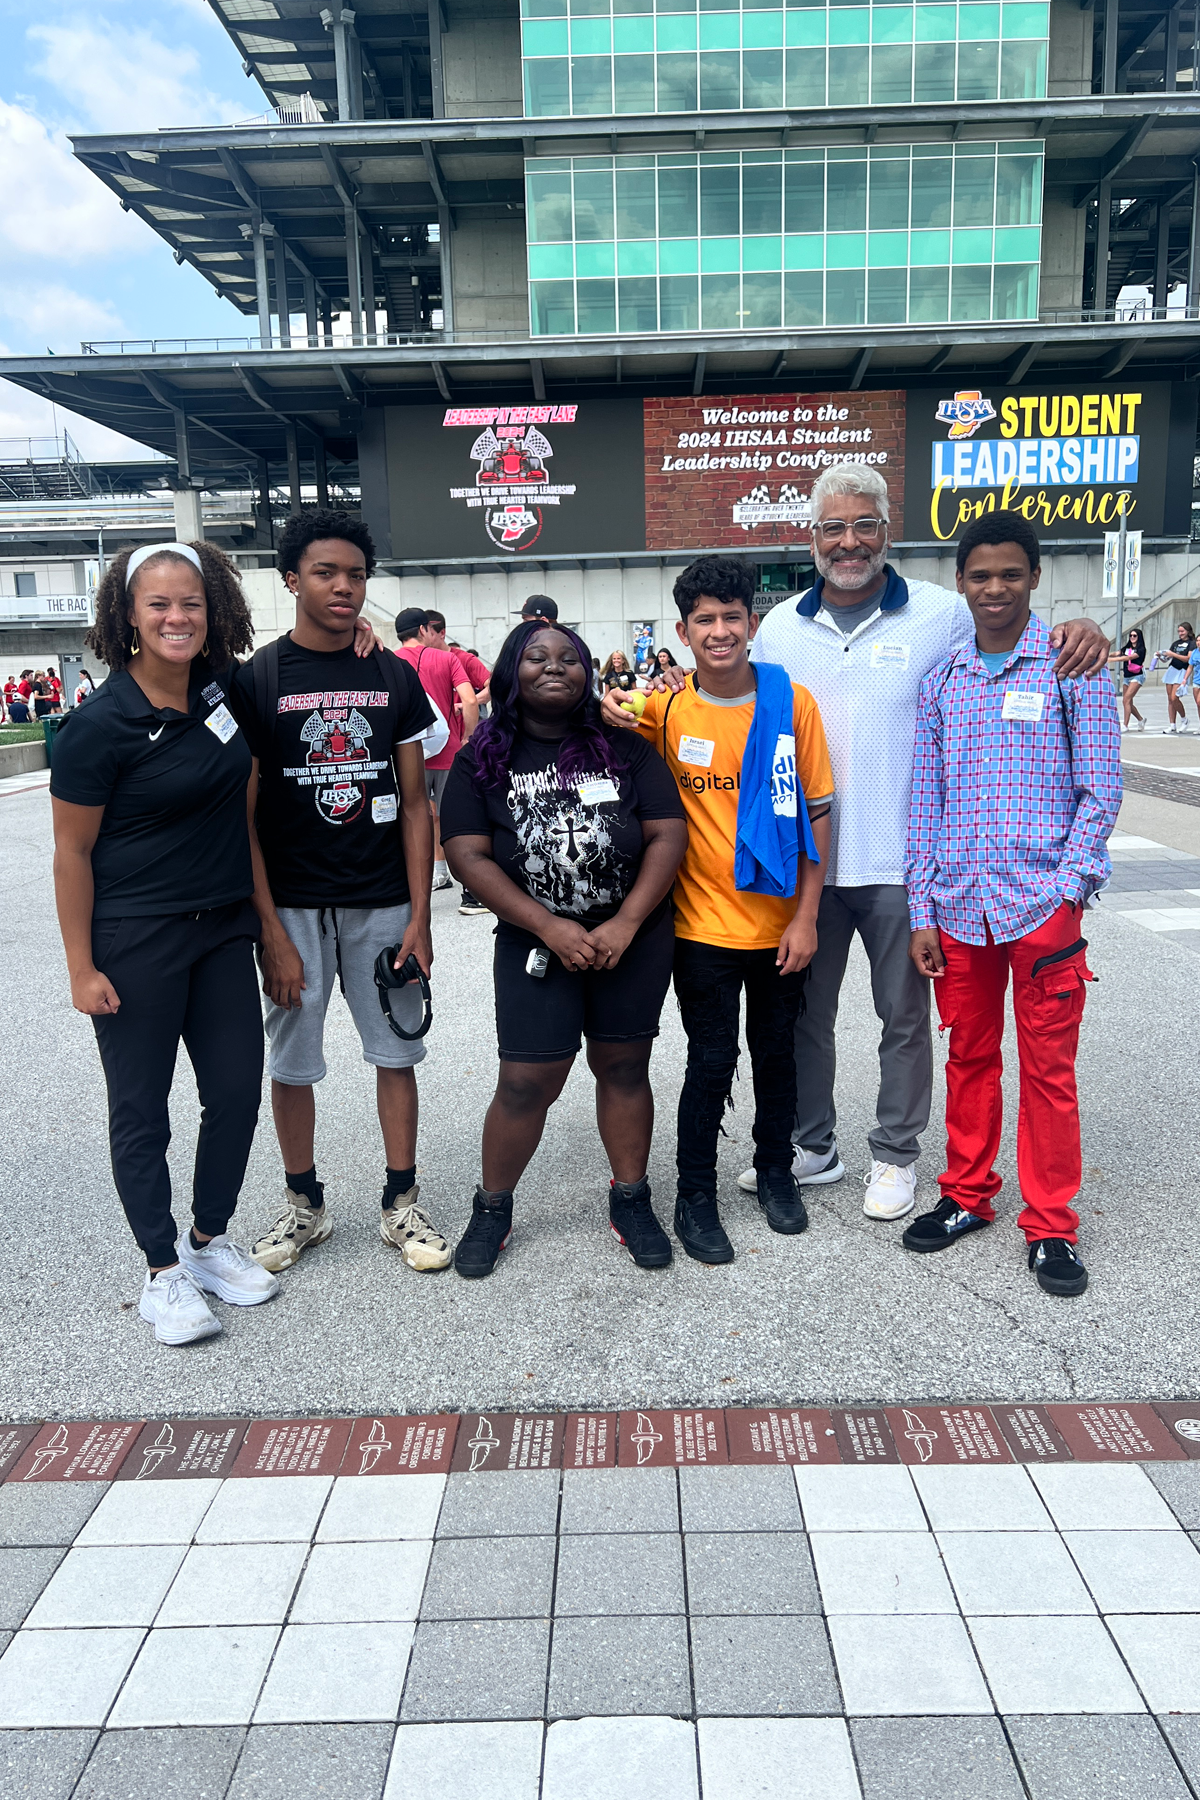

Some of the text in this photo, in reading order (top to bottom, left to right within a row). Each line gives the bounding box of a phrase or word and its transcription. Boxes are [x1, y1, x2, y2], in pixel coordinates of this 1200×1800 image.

[443, 404, 578, 426] LEADERSHIP IN THE FAST LANE
[702, 404, 849, 425] Welcome to the
[938, 400, 996, 425] IHSAA
[1000, 393, 1142, 438] STUDENT
[496, 426, 526, 438] 2024
[677, 427, 873, 448] 2024 IHSAA Student
[661, 449, 888, 471] Leadership Conference
[934, 437, 1139, 487] LEADERSHIP
[450, 484, 577, 498] TOGETHER WE DRIVE TOWARDS LEADERSHIP
[466, 498, 482, 507] WITH
[483, 497, 498, 506] TRUE
[499, 496, 526, 505] HEARTED
[930, 475, 1137, 540] Conference
[46, 598, 65, 612] THE
[277, 691, 389, 714] LEADERSHIP IN THE FAST LANE
[323, 709, 348, 720] 2024
[283, 767, 310, 777] TOGETHER
[310, 766, 319, 775] WE
[320, 765, 336, 774] DRIVE
[337, 763, 363, 773] TOWARDS
[297, 776, 312, 785] WITH
[313, 775, 327, 784] TRUE
[328, 773, 352, 782] HEARTED
[680, 772, 741, 794] digital
[322, 787, 360, 803] IHSAA
[523, 1419, 533, 1434] SHELL
[545, 1419, 554, 1431] SAM
[587, 1417, 596, 1434] DADDY
[673, 1413, 681, 1435] MEMORY
[695, 1413, 704, 1436] BRAYTON
[844, 1413, 856, 1434] MEMORY
[1014, 1408, 1030, 1427] WINNER
[1095, 1406, 1113, 1425] LOVING
[1108, 1408, 1128, 1430] BROTHER
[1119, 1409, 1145, 1438] AND FRIEND
[306, 1429, 319, 1448] FRIEND
[512, 1417, 522, 1441] MEMORY
[534, 1424, 543, 1436] MISS
[684, 1416, 695, 1458] BIG LEE BRAYTON
[768, 1412, 786, 1461] LAW ENFORCEMENT
[958, 1426, 973, 1448] MEMORY
[962, 1409, 990, 1458] DEVOTED RACE FAN
[973, 1411, 1000, 1455] FAREWELL FRIEND
[1082, 1420, 1101, 1442] MEMORY
[1085, 1409, 1119, 1452] ANDY EDGAR SELF
[63, 1424, 102, 1477] ARTHUR LOMBARDO
[96, 1426, 132, 1475] FOREVER INDY FAN
[177, 1429, 204, 1471] THE SHUMARDS
[201, 1438, 220, 1467] JON JON
[210, 1453, 225, 1472] CHUCK
[222, 1428, 236, 1446] AMBER
[254, 1428, 278, 1468] RACE WEEKEND
[264, 1443, 282, 1470] MEMORIES
[276, 1431, 287, 1442] FOR
[286, 1425, 310, 1470] TODD WINELAND
[421, 1436, 433, 1459] FOREVER
[432, 1427, 446, 1460] OUR HEARTS
[508, 1442, 519, 1461] LOVING
[531, 1443, 540, 1456] LOVE
[543, 1437, 552, 1449] DAD
[674, 1436, 683, 1455] LOVING
[696, 1437, 706, 1456] SCOTTY
[796, 1437, 808, 1460] BELOVED
[808, 1441, 817, 1453] AND
[850, 1435, 863, 1453] LOVING
[873, 1436, 884, 1448] DAD
[954, 1443, 967, 1459] MACK
[1019, 1437, 1031, 1449] TOM
[1028, 1433, 1046, 1455] FOREVER
[1111, 1431, 1133, 1454] DEVOTED
[90, 1454, 104, 1467] INDY
[309, 1440, 326, 1468] INDY RACE
[398, 1452, 408, 1464] RICK
[530, 1458, 538, 1466] WE
[574, 1452, 583, 1465] DALE
